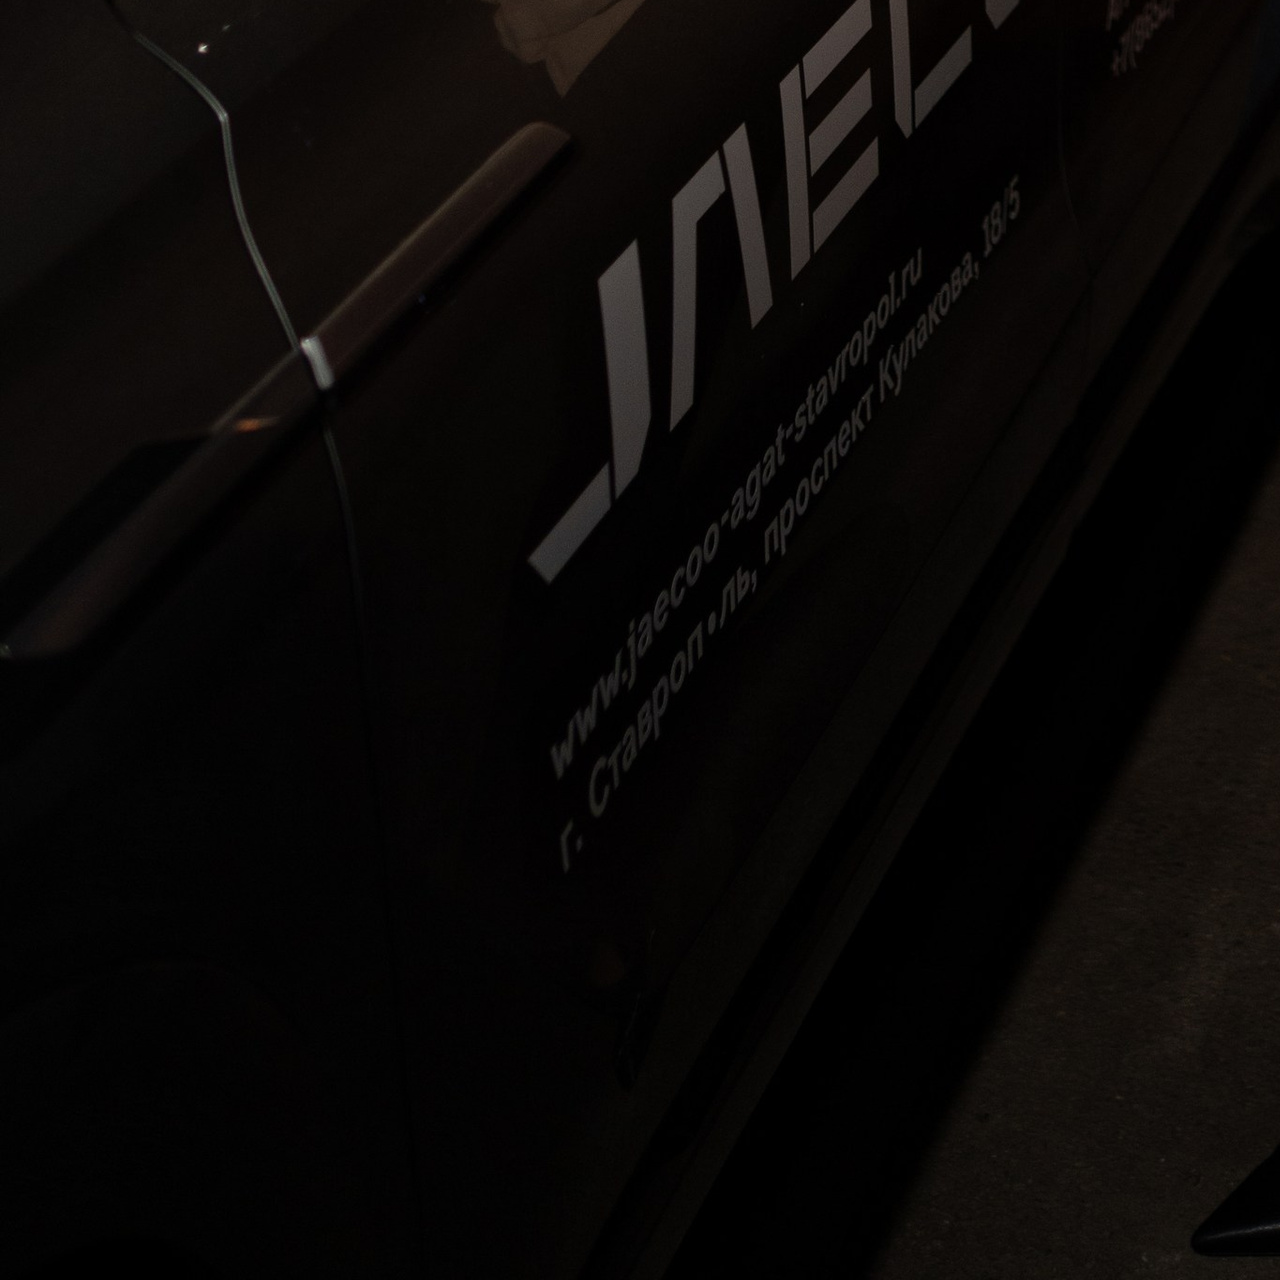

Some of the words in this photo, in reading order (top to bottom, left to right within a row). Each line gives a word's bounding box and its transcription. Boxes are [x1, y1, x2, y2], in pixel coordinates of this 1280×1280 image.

[551, 249, 923, 780] www.jaecoo-agat-stavropol.ru
[559, 819, 583, 873] г.
[763, 383, 876, 565] проспект
[878, 250, 981, 402] Кулакова,
[981, 175, 1021, 256] 18/5
